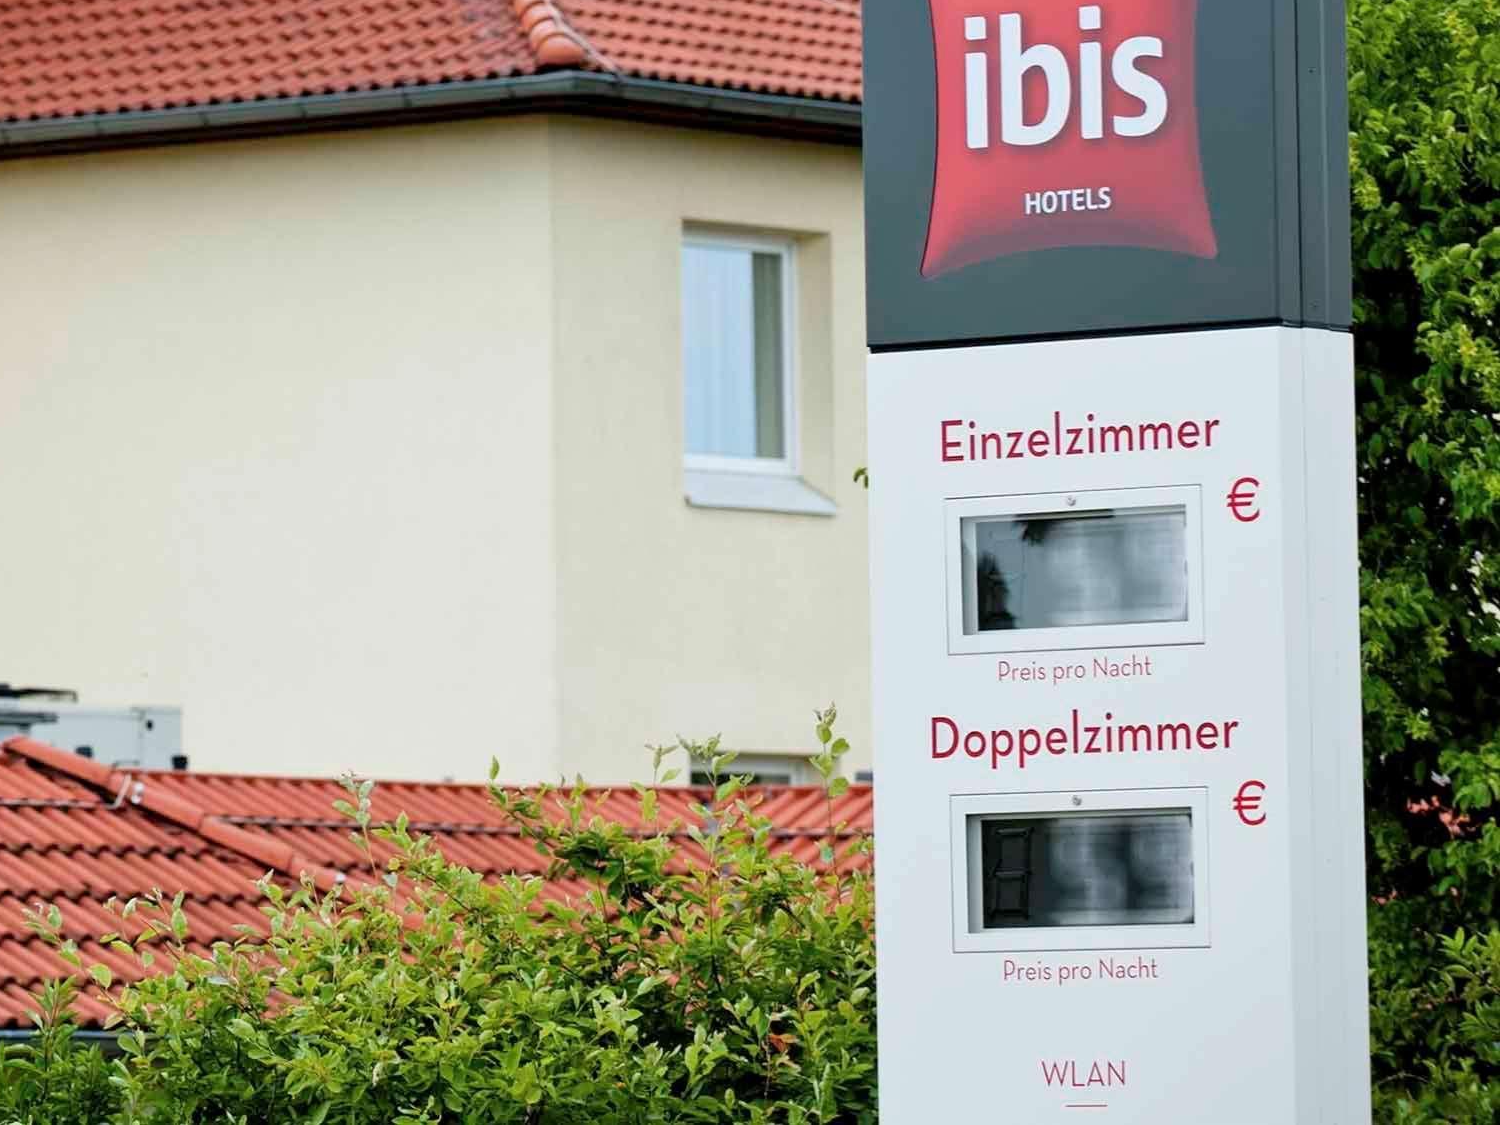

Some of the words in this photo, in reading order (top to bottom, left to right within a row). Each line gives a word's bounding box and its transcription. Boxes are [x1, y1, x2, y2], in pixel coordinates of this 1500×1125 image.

[963, 5, 1168, 149] ibis
[1024, 186, 1112, 215] HOTELS
[940, 411, 1220, 463] Einzelzimmer
[1226, 477, 1261, 523] €
[997, 660, 1046, 682] Preis
[1052, 662, 1086, 686] pro
[1093, 655, 1153, 679] Nacht
[930, 709, 1239, 770] Doppelzimmer
[1233, 780, 1267, 826] €
[1002, 958, 1053, 982] Preis
[1057, 962, 1092, 986] pro
[1098, 956, 1159, 980] Nacht
[1041, 1060, 1127, 1087] WLAN
